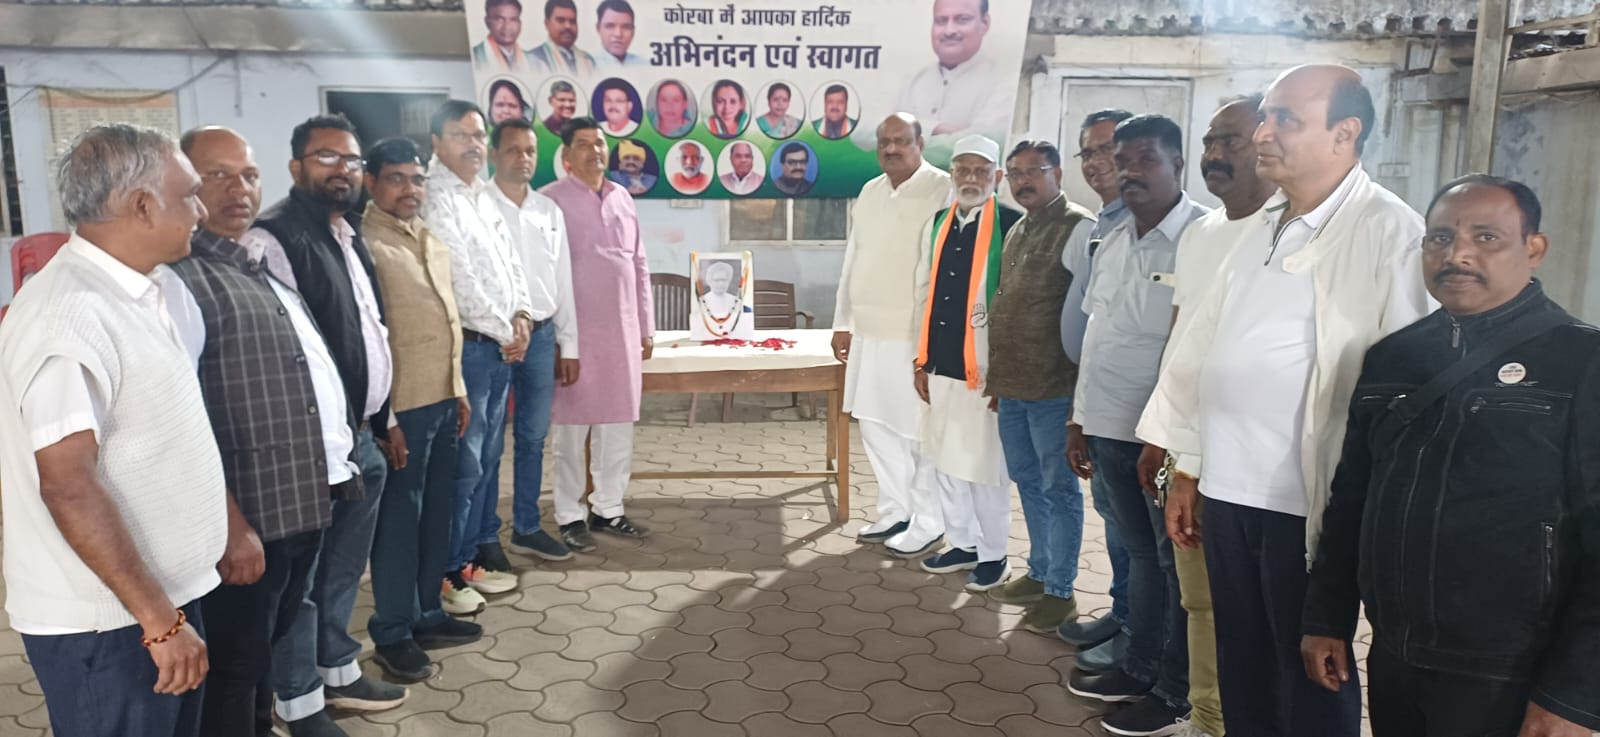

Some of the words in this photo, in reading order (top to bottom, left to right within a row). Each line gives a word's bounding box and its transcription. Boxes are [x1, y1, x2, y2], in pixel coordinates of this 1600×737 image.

[664, 4, 713, 25] कोरबा
[719, 4, 735, 26] में
[741, 9, 796, 27] आपका
[801, 6, 852, 28] हार्दिक
[649, 35, 757, 69] अभिनंदन
[764, 36, 802, 69] एवं
[806, 45, 882, 70] स्वागत
